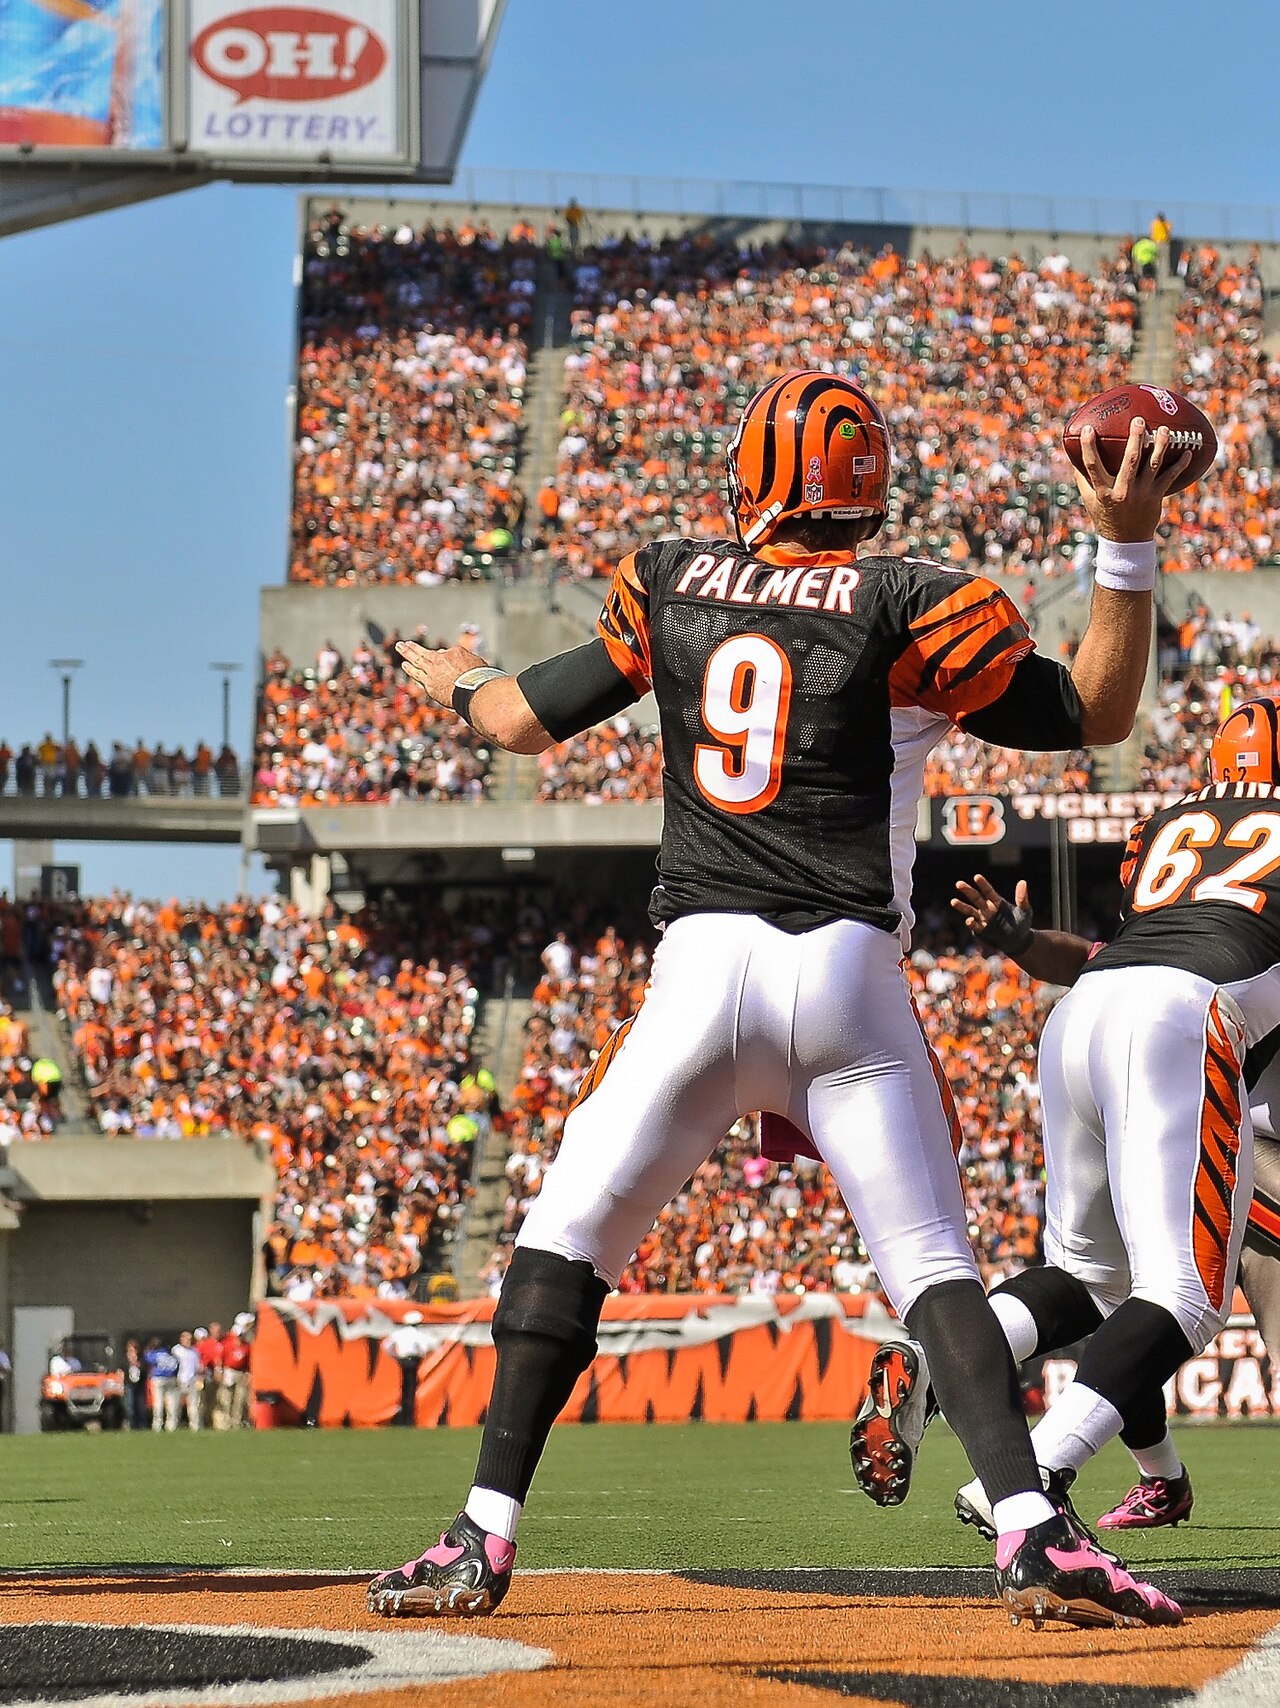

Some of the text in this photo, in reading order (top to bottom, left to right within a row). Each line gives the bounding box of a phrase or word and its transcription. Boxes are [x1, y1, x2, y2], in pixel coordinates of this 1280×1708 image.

[203, 25, 369, 81] OH!
[205, 112, 378, 141] LOTTERY
[675, 553, 862, 615] PALMER
[693, 632, 793, 815] 9
